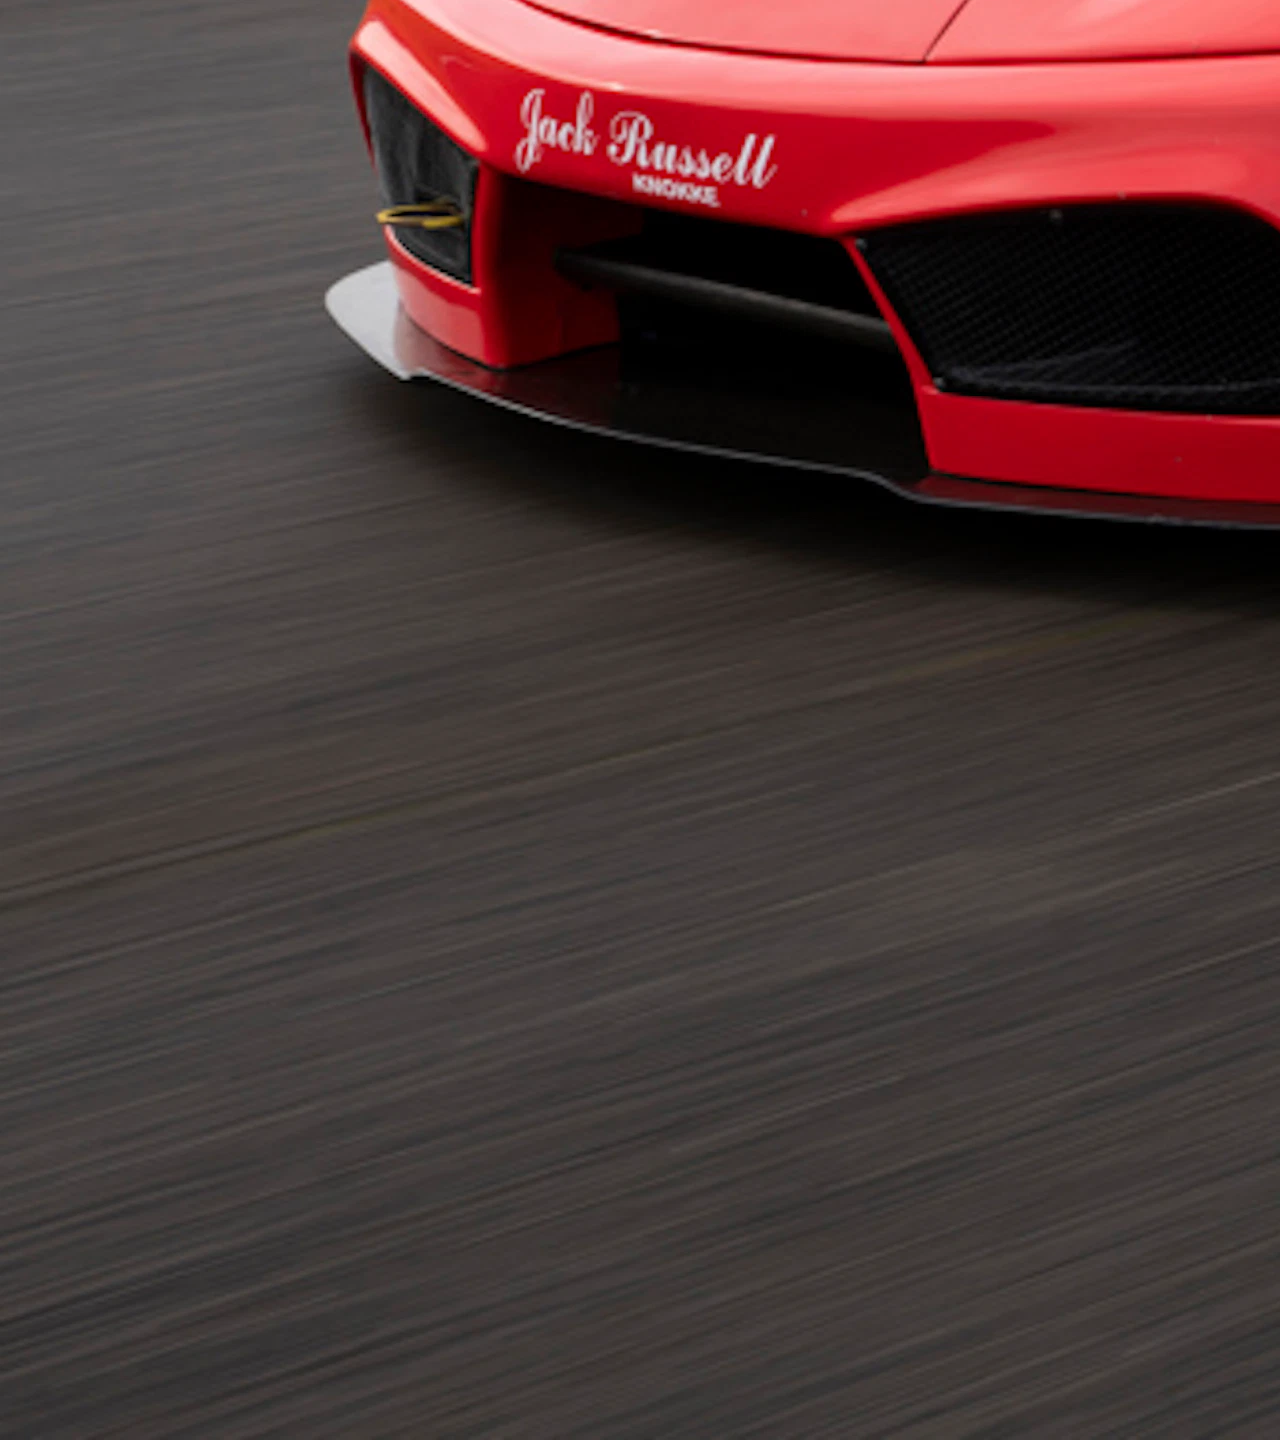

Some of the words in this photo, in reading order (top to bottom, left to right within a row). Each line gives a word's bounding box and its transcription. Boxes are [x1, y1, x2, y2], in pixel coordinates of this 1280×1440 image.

[513, 88, 601, 173] Jack
[605, 110, 778, 189] Russell
[631, 172, 721, 208] KNOKKE
